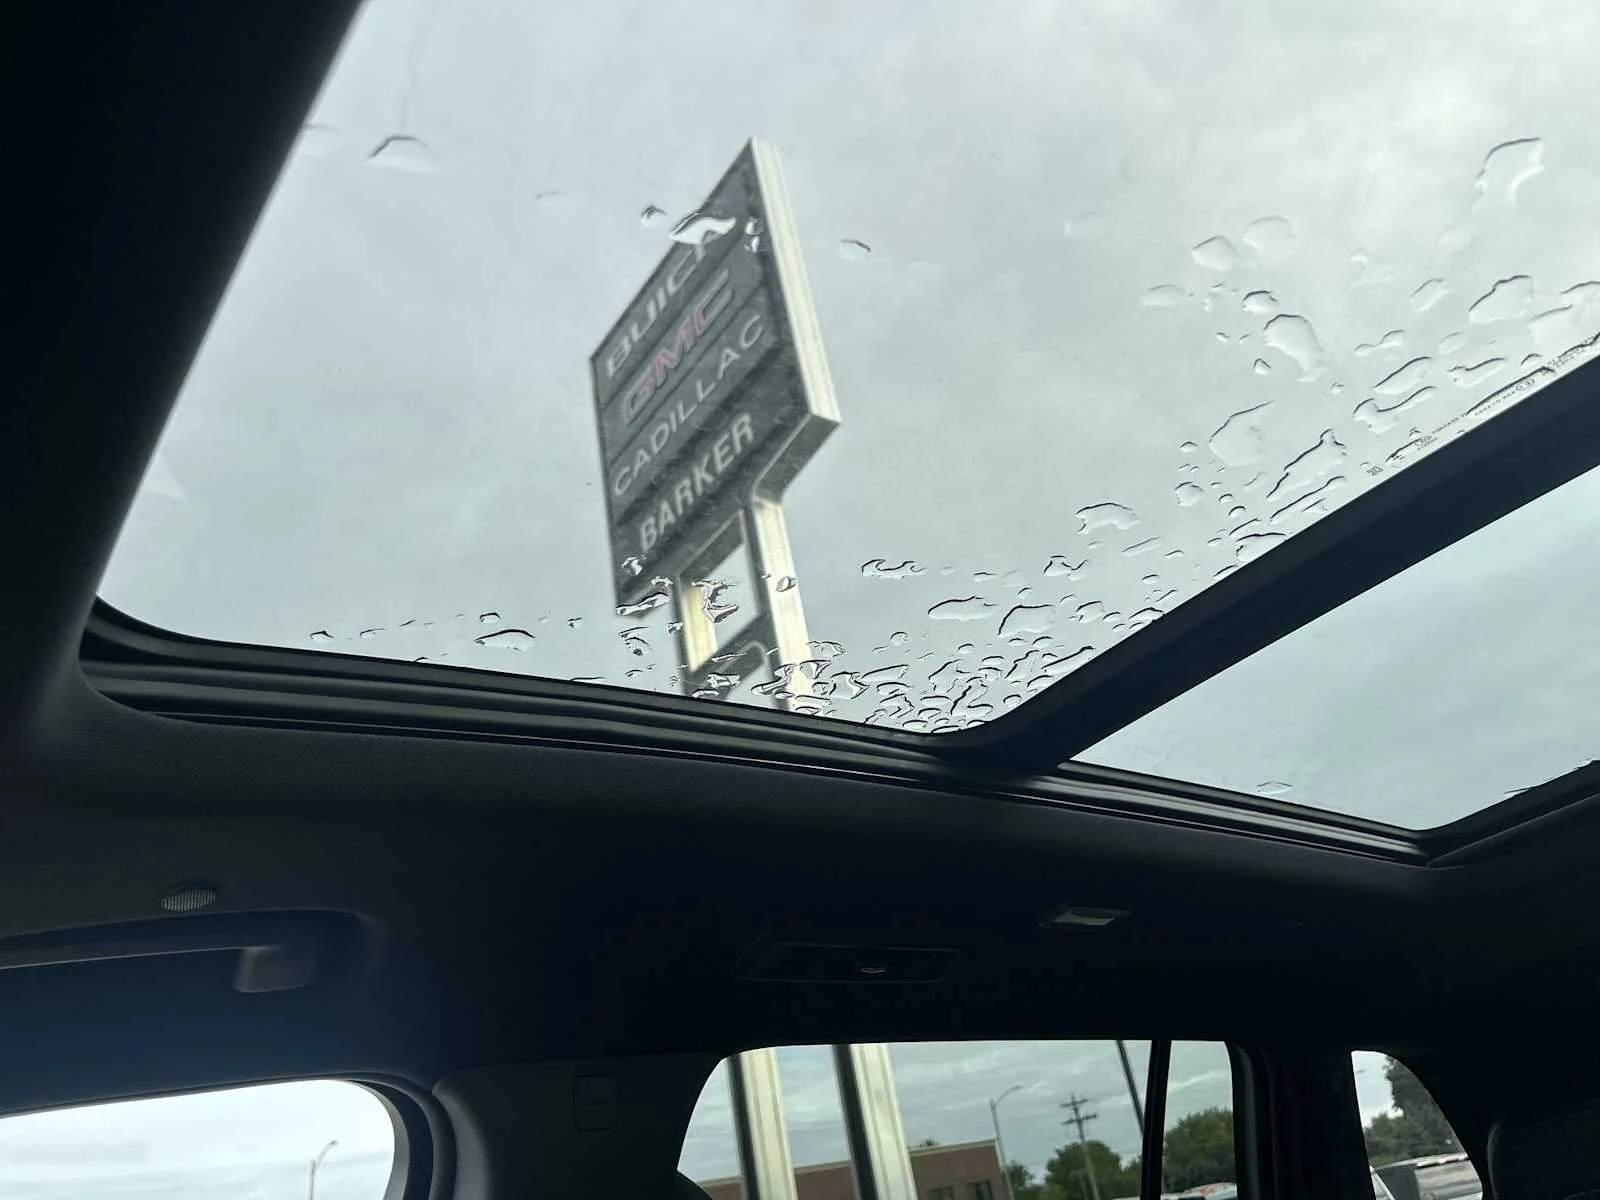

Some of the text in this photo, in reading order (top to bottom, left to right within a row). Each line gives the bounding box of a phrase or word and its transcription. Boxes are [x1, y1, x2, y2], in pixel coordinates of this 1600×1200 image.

[614, 314, 764, 496] CADILLAC
[623, 268, 735, 424] GMC
[640, 412, 755, 552] BARKER
